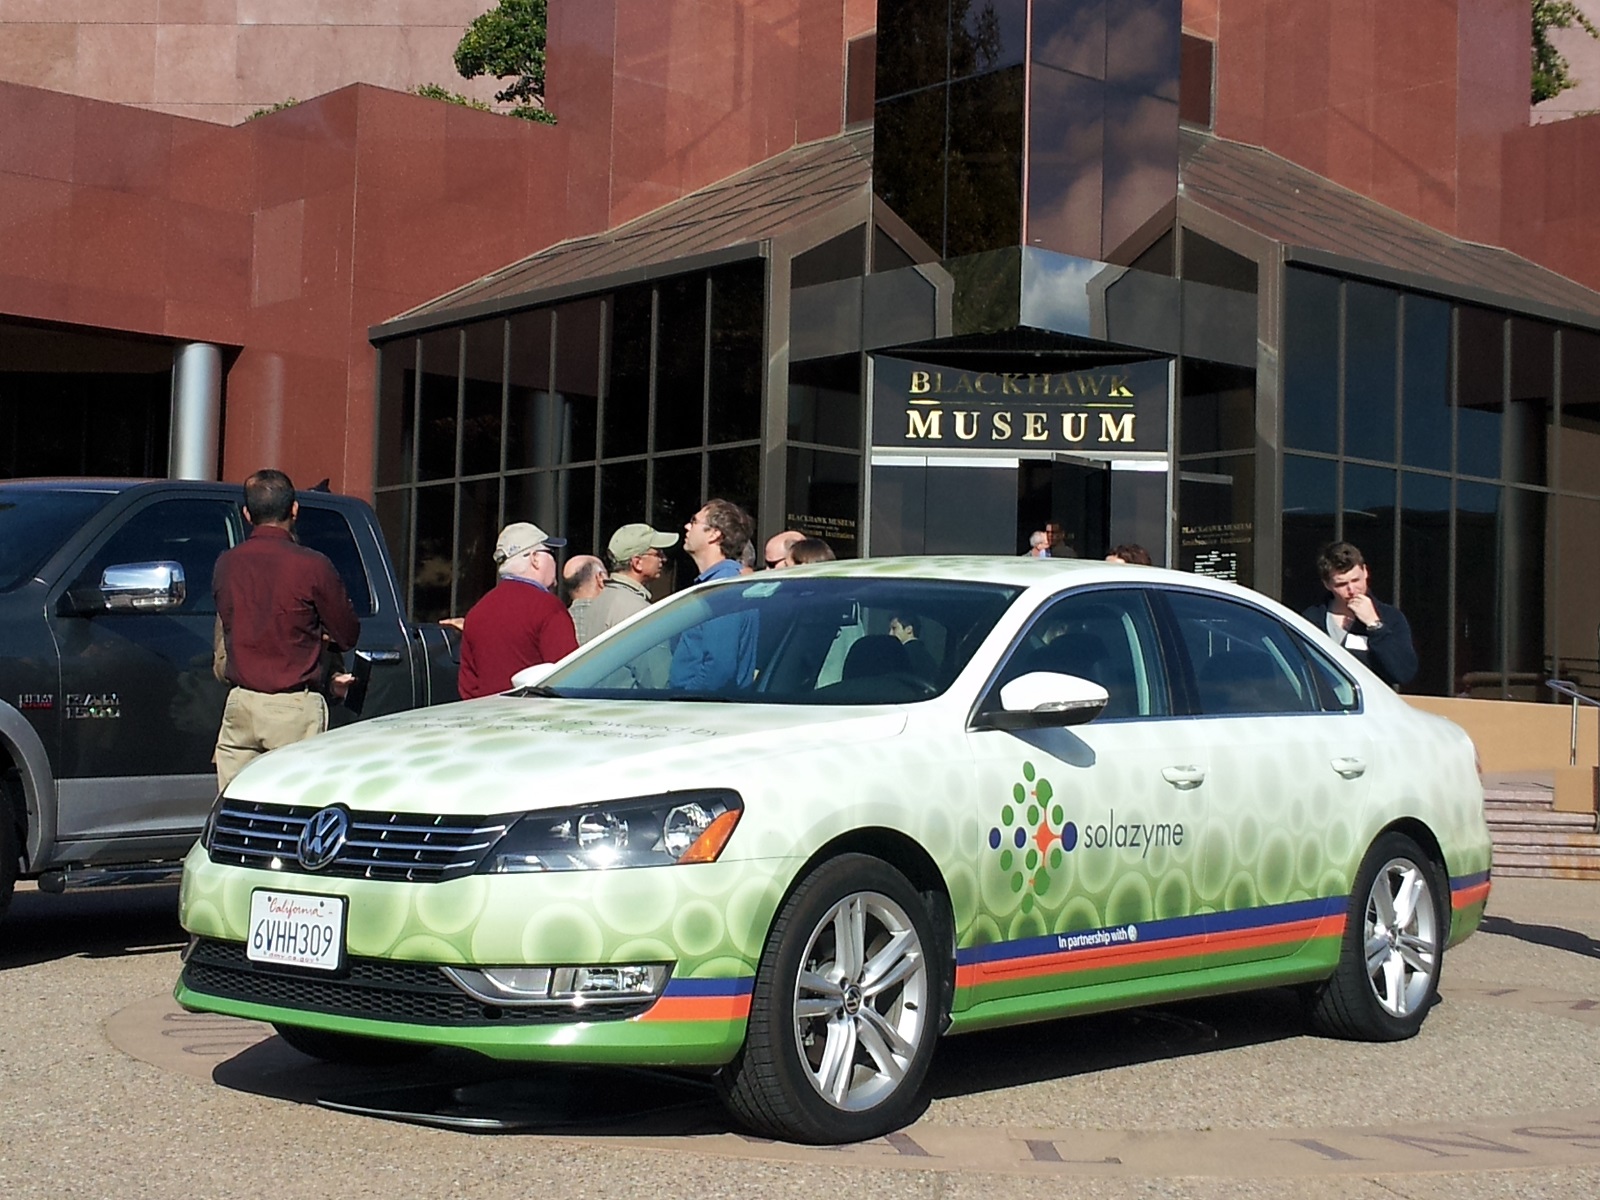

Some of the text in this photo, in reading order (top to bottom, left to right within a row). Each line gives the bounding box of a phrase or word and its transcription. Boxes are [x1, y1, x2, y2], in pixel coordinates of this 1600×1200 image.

[908, 370, 1134, 398] BLACKHAWK
[905, 409, 1136, 443] MUSEUM
[1084, 808, 1184, 858] solazyme
[269, 897, 324, 919] California
[253, 918, 333, 957] 6VHH309
[1058, 927, 1128, 950] In partnership with
